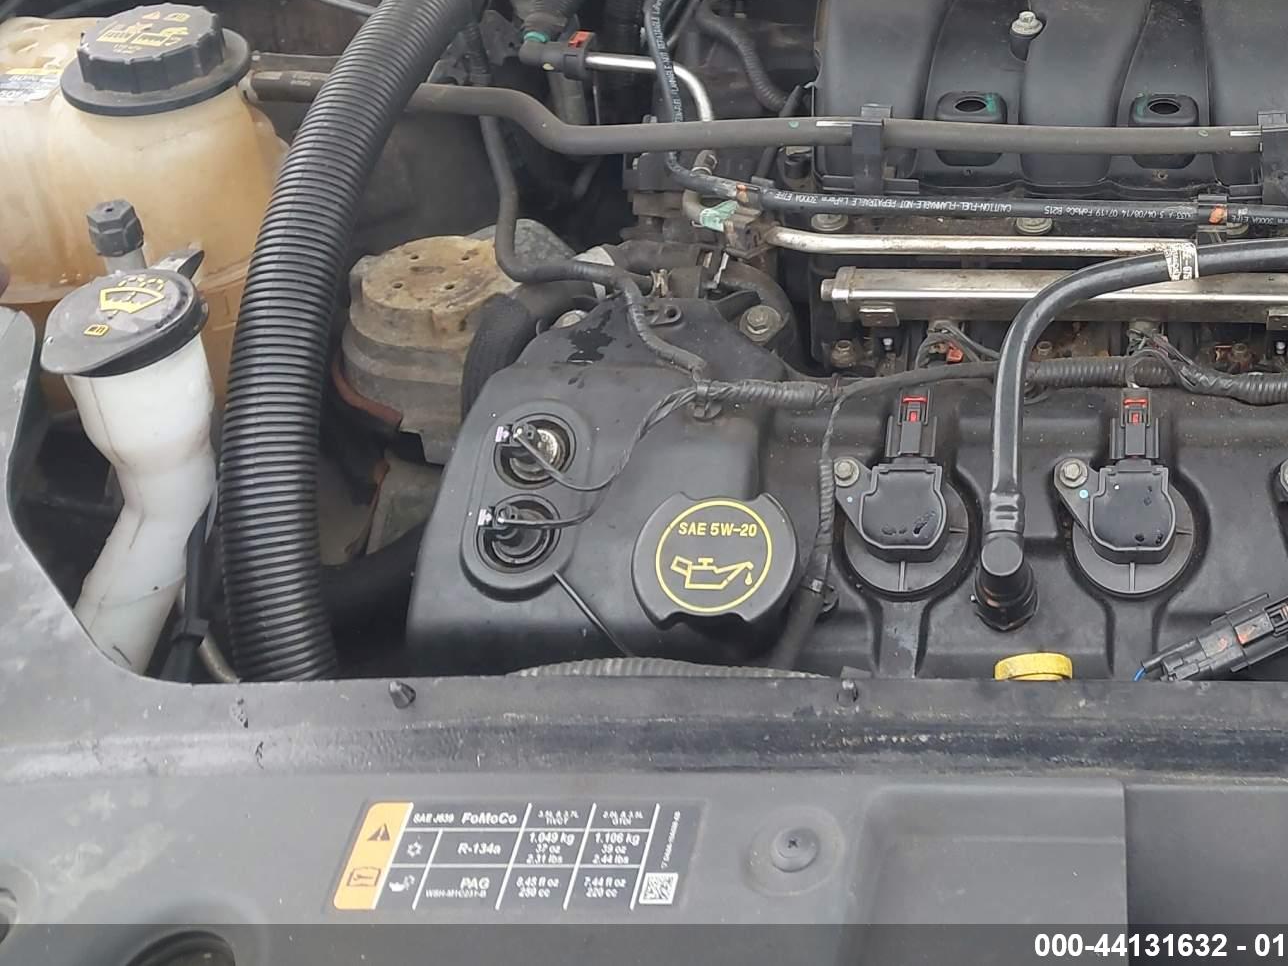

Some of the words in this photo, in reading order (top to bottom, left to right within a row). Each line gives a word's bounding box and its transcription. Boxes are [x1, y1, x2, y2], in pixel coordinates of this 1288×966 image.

[678, 521, 707, 536] SAE
[709, 522, 757, 537] 5W-20
[461, 812, 518, 824] FoMoCo
[529, 833, 558, 844] 1.049
[560, 833, 575, 846] kg
[595, 833, 624, 844] 1.106
[626, 833, 640, 846] kg
[458, 842, 501, 855] R-134a
[615, 845, 627, 854] oz
[460, 877, 490, 890] PAG
